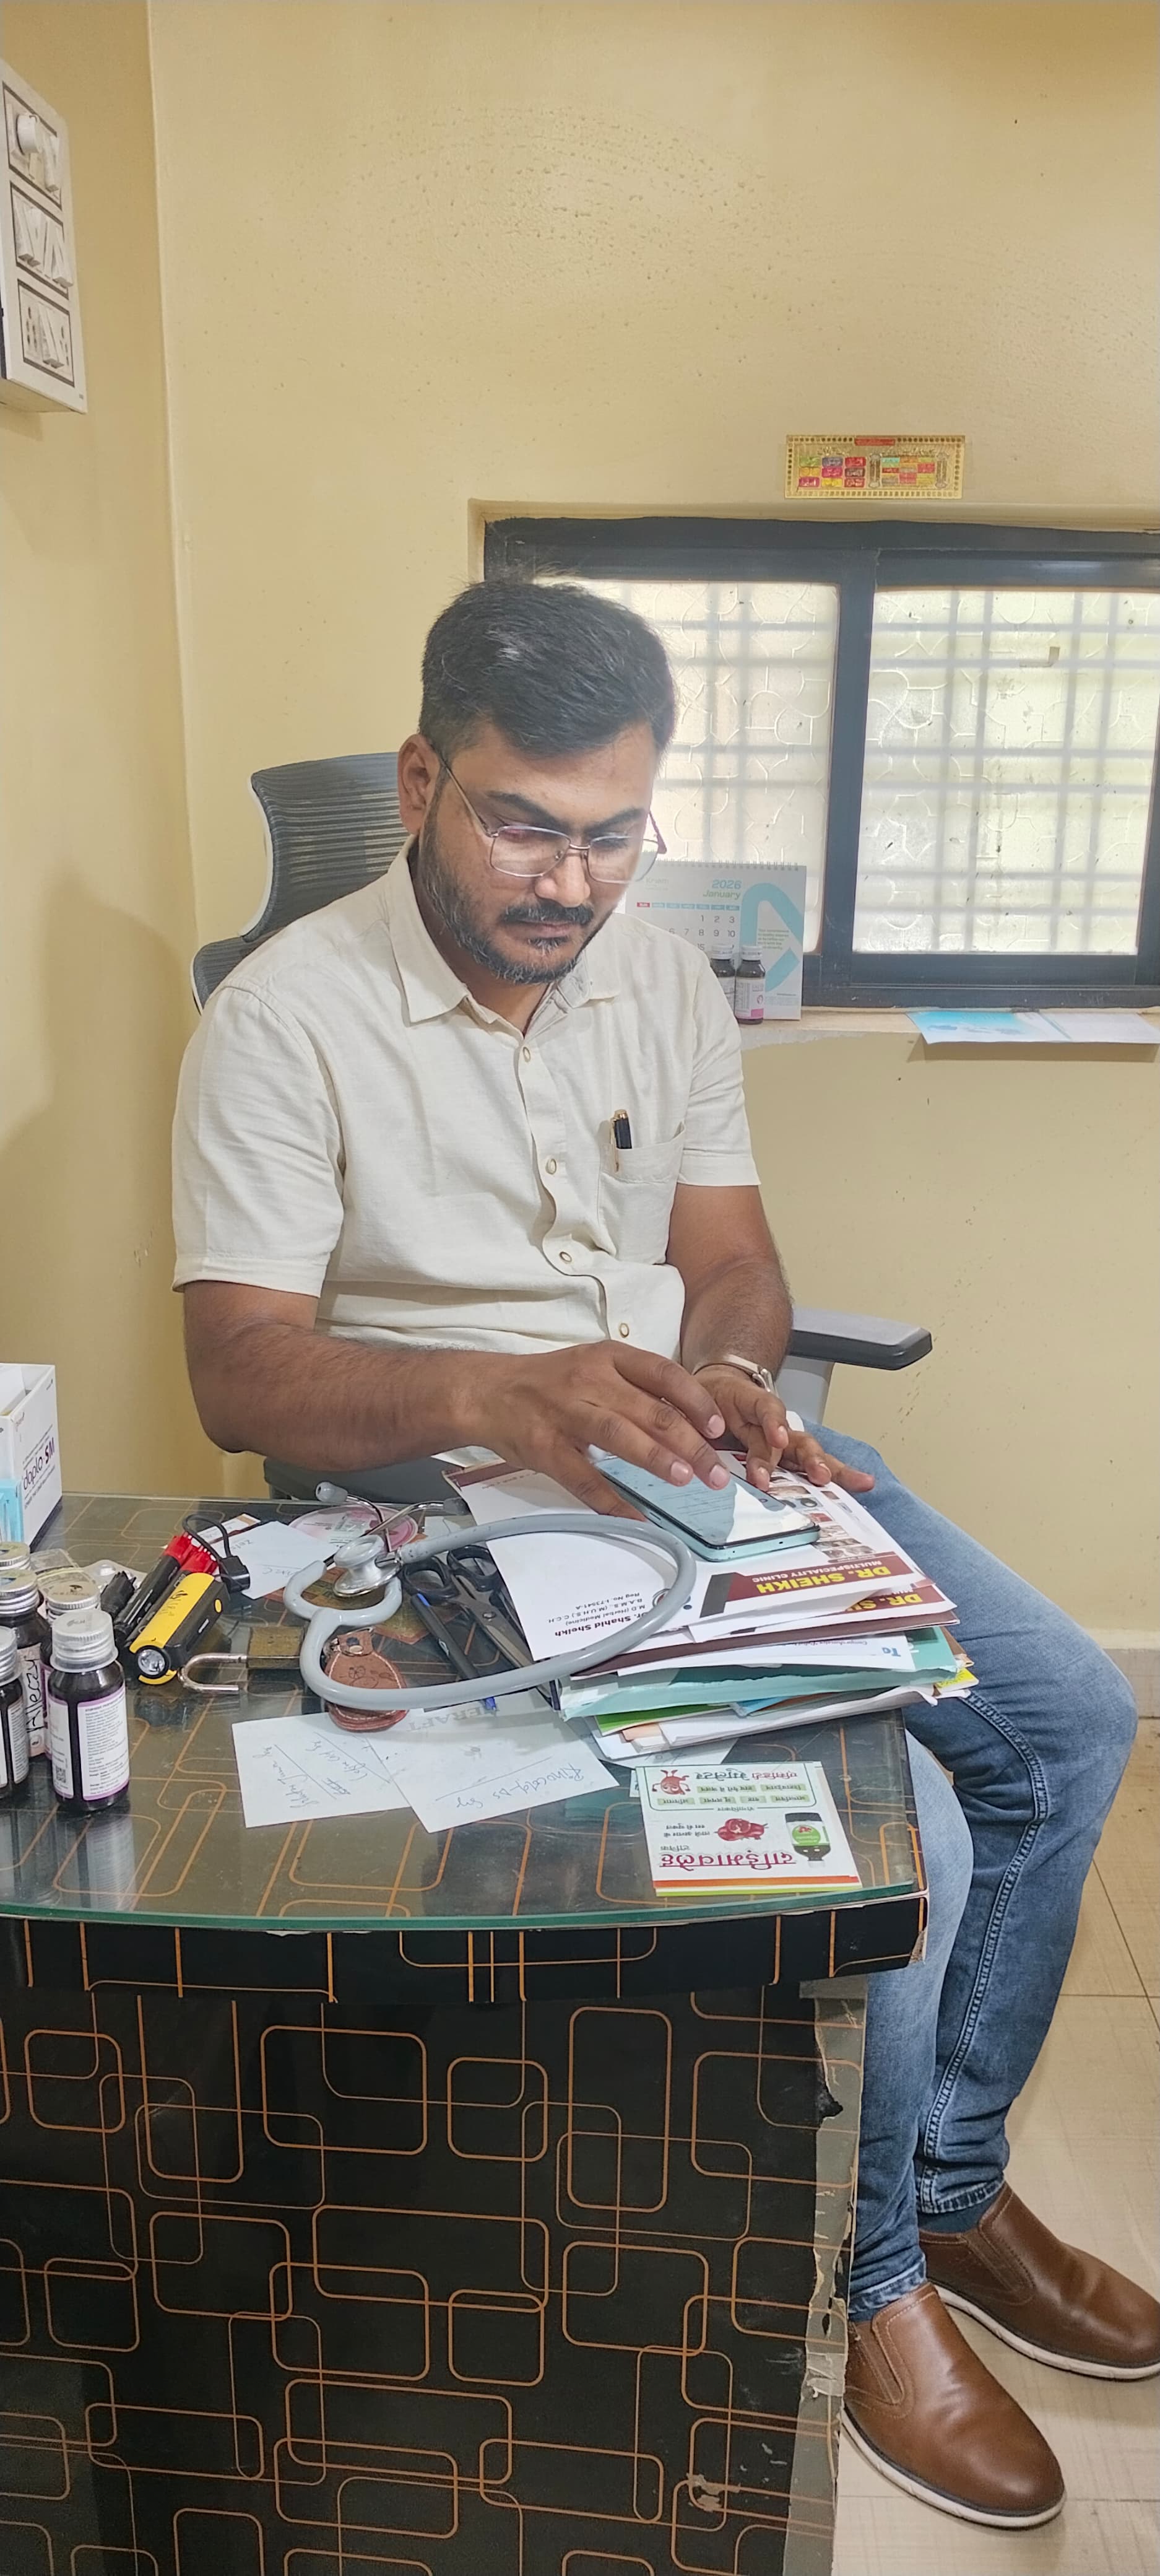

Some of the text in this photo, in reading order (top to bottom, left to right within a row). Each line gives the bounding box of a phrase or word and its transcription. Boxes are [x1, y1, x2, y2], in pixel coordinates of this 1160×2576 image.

[712, 879, 742, 890] 2026
[703, 890, 741, 900] January
[752, 1560, 882, 1583] MULTISPECIALITY CLINIC
[756, 1565, 891, 1594] DR. SHEIKH
[878, 1593, 922, 1606] DR.
[602, 1608, 629, 1617] (Herbal
[565, 1615, 600, 1626] Medicine)
[594, 1616, 631, 1629] Shahid
[555, 1625, 591, 1637] Sheikh
[695, 1768, 750, 1782] रेगुलेटर
